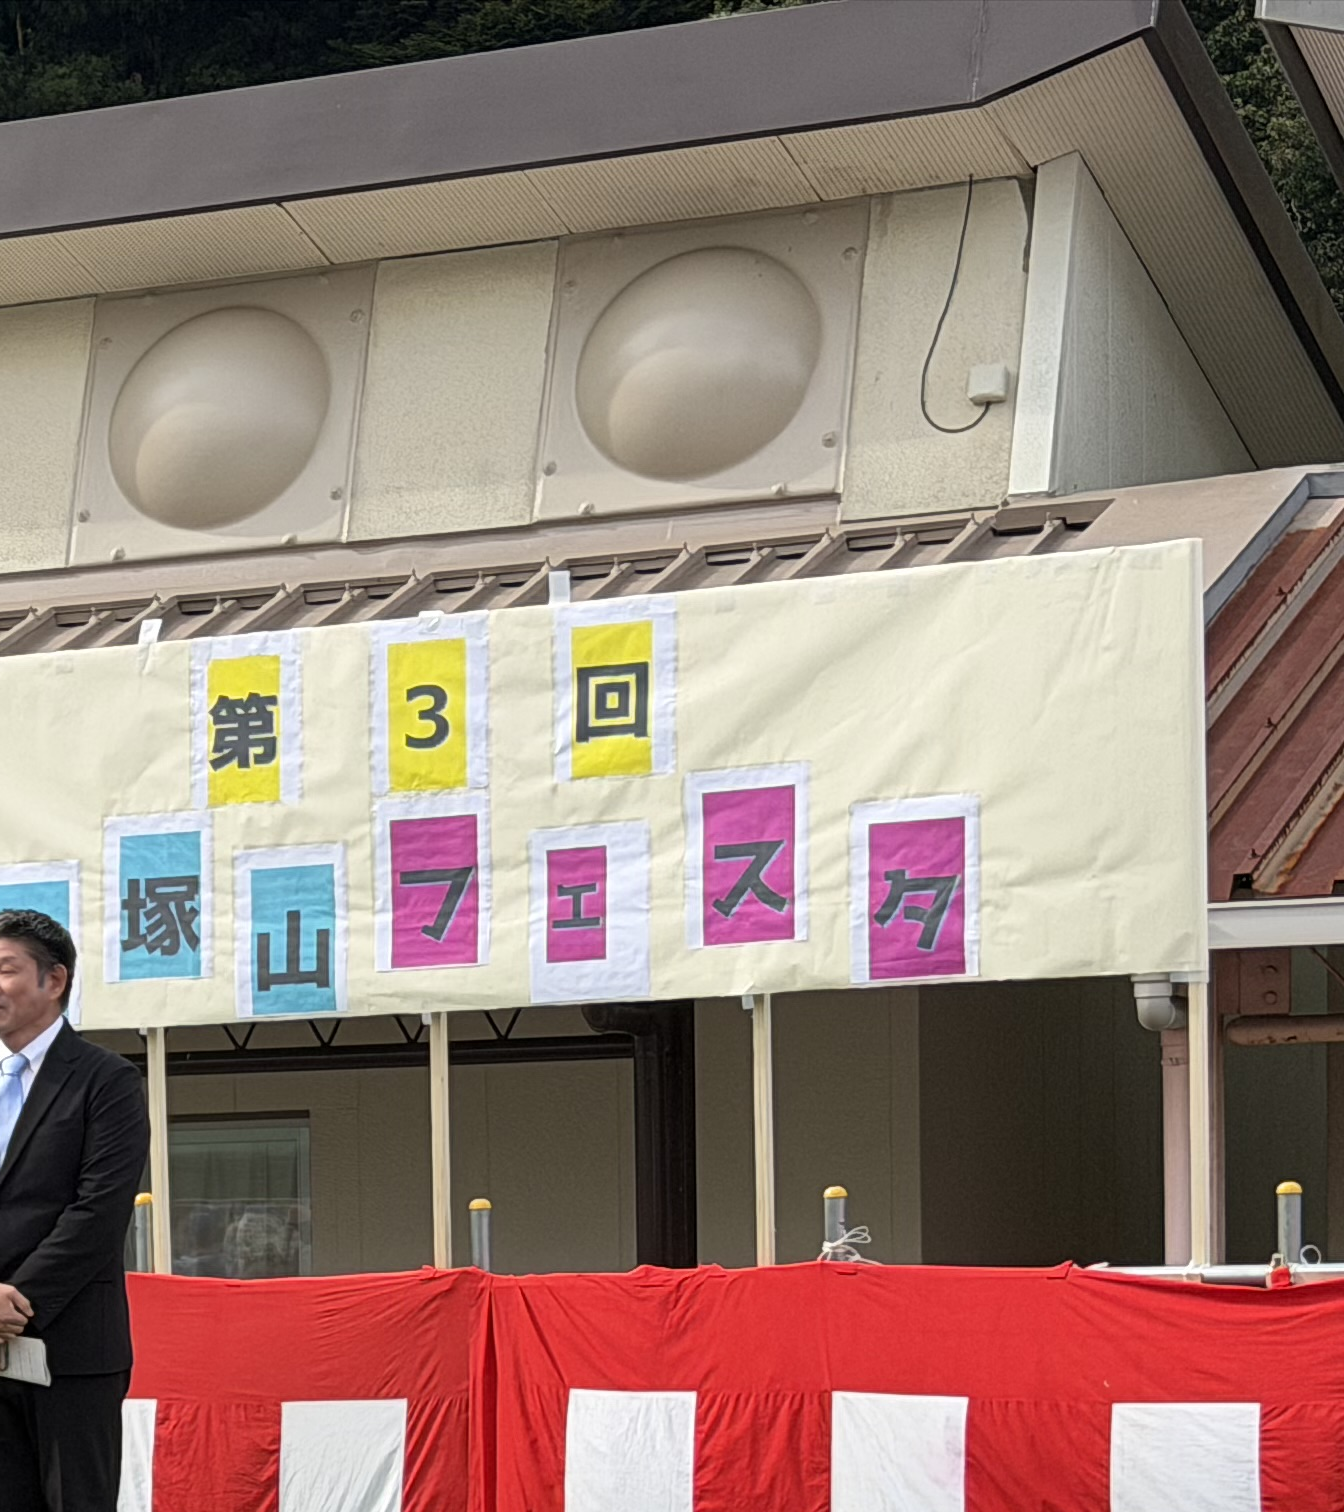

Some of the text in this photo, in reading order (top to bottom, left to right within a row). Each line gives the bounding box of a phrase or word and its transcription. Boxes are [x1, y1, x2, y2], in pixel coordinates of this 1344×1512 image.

[207, 660, 650, 771] 第3回
[120, 838, 961, 993] 塚山フェスタ
